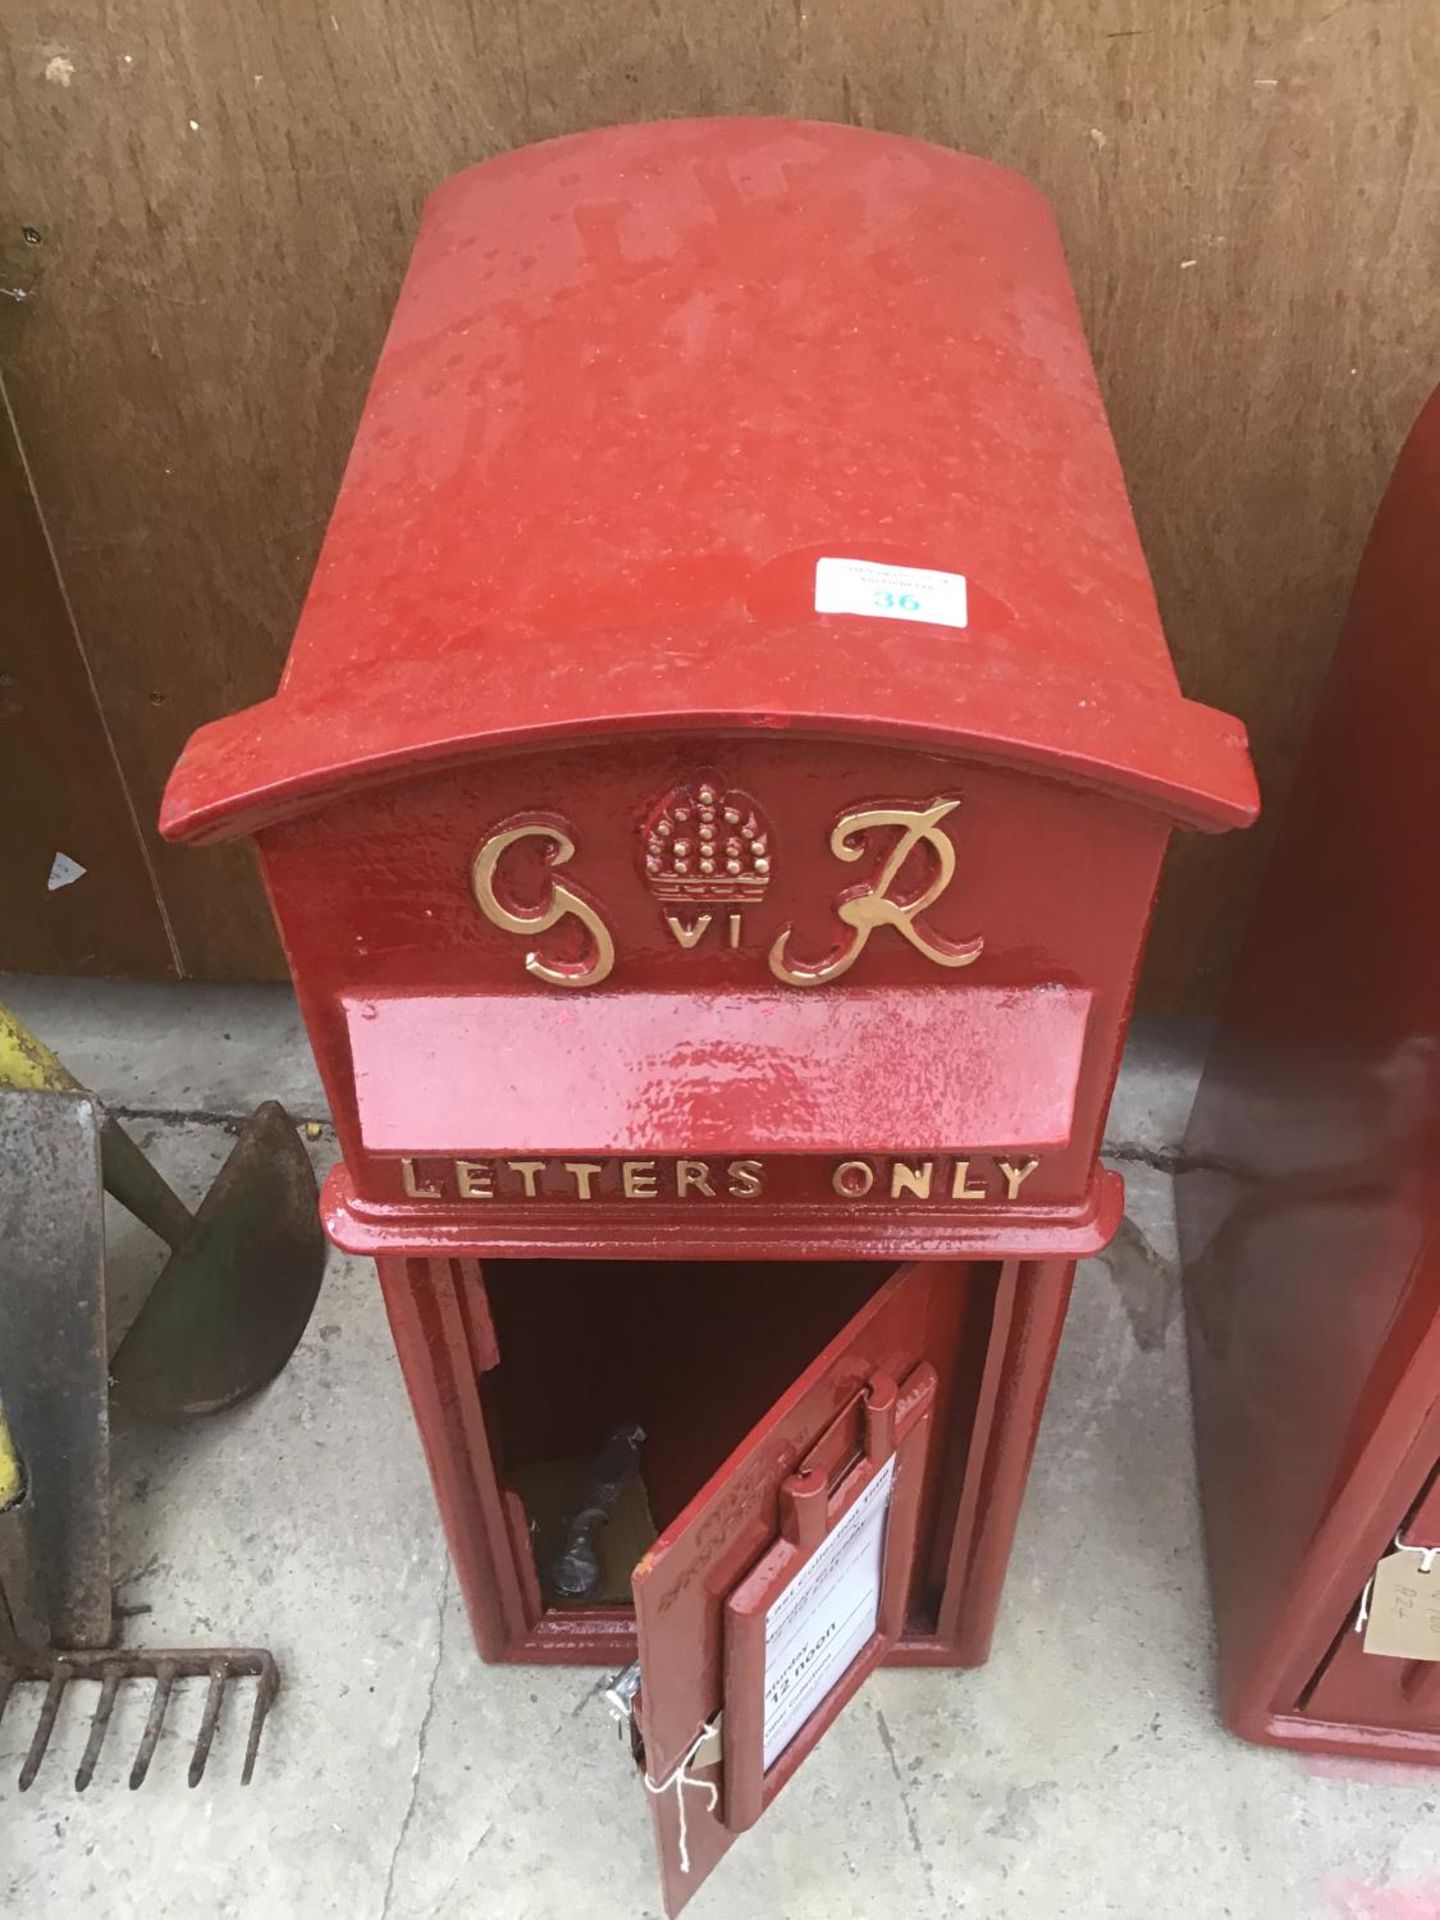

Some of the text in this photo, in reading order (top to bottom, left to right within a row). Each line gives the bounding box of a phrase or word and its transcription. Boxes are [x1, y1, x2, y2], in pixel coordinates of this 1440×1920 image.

[874, 591, 920, 610] 36
[472, 799, 984, 987] G R
[666, 912, 742, 949] VI
[400, 1157, 1040, 1201] LETTERS ONLY
[765, 1641, 808, 1700] aturday
[773, 1678, 789, 1703] 12
[795, 1622, 836, 1677] noon
